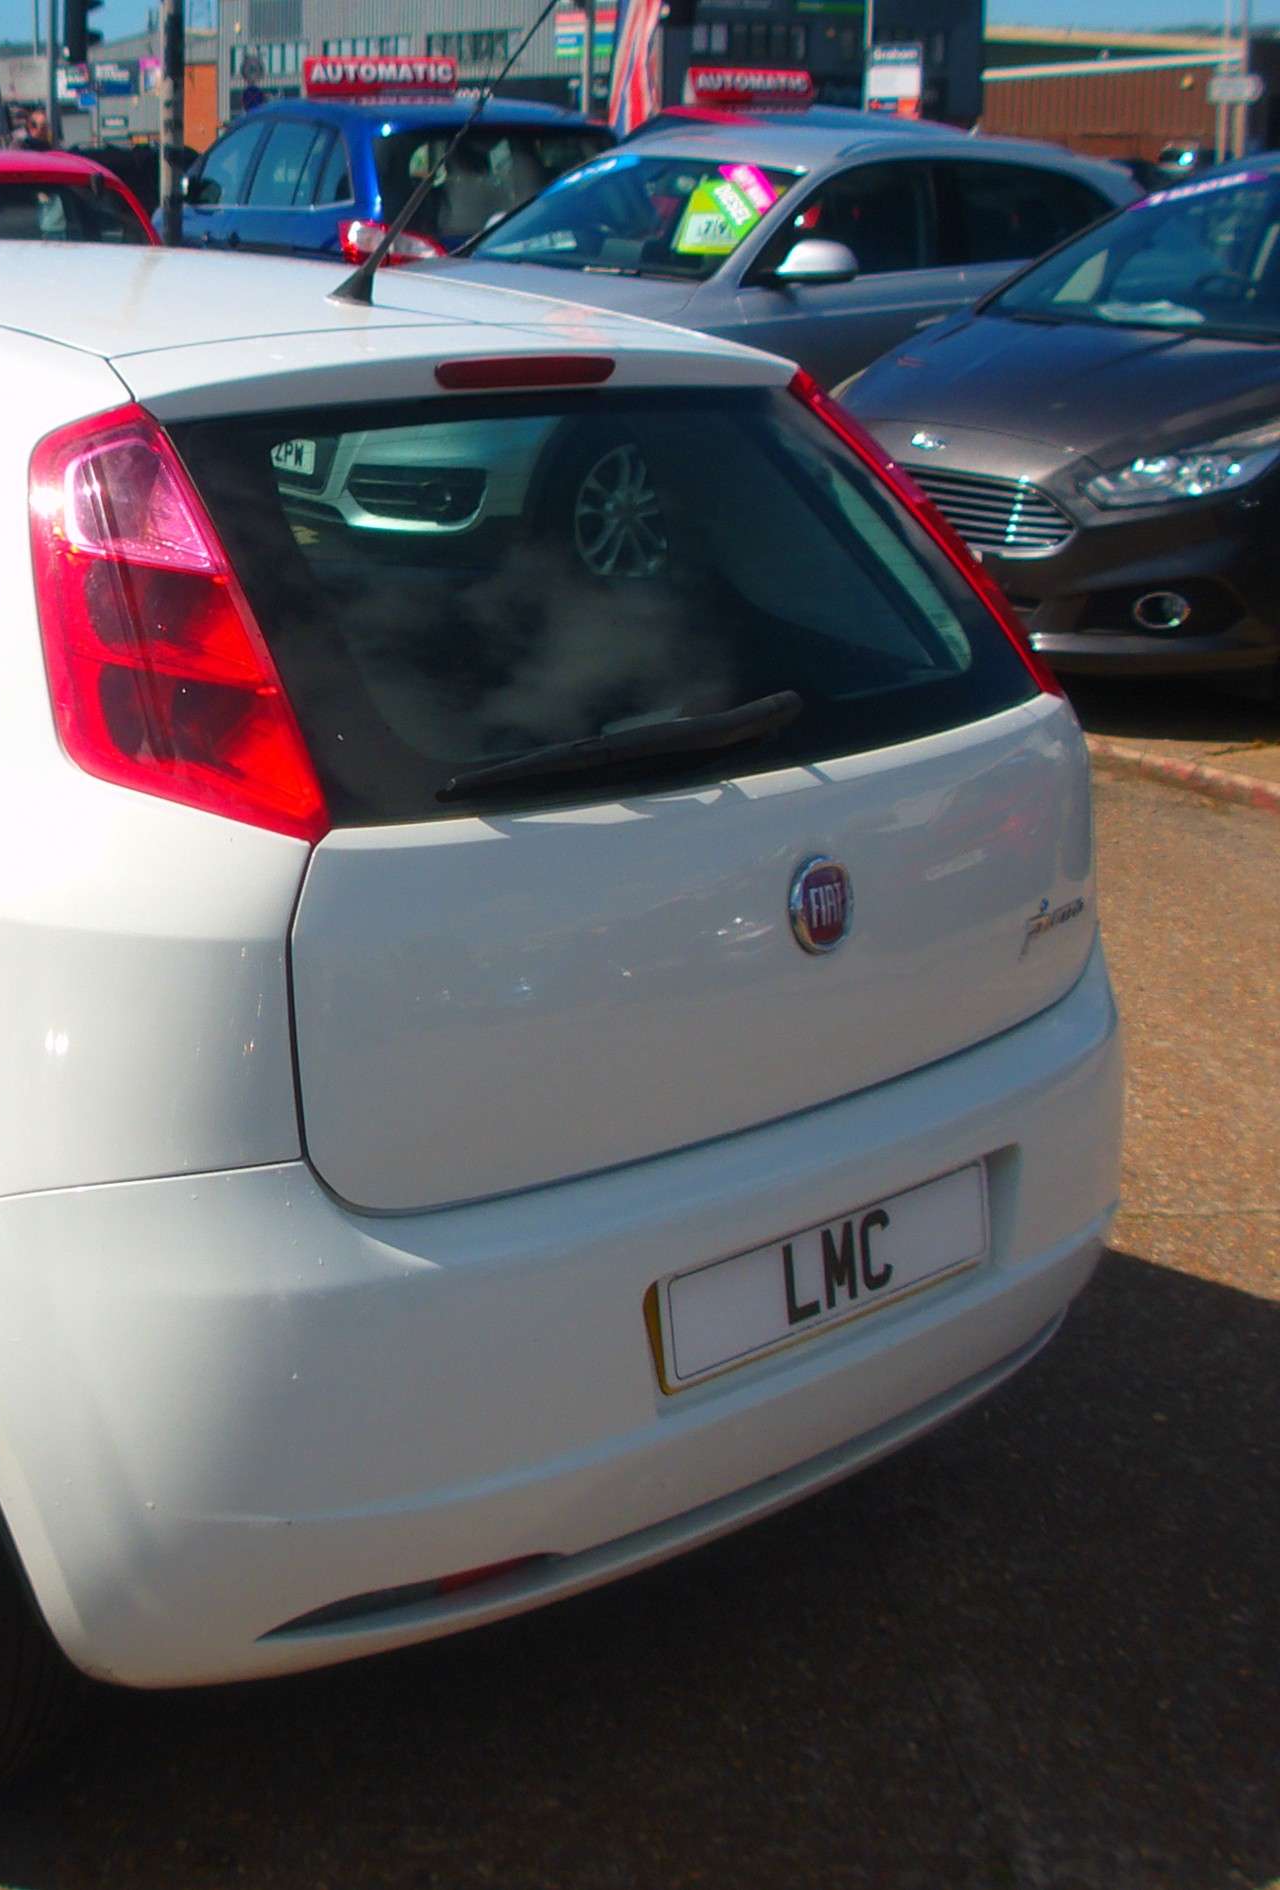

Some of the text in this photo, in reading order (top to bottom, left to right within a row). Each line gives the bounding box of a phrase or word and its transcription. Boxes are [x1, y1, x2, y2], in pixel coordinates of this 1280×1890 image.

[310, 62, 454, 83] AUTOMATIC
[697, 73, 808, 92] AUTOMATIC
[809, 882, 842, 929] FIAT
[782, 1208, 894, 1326] LMC
